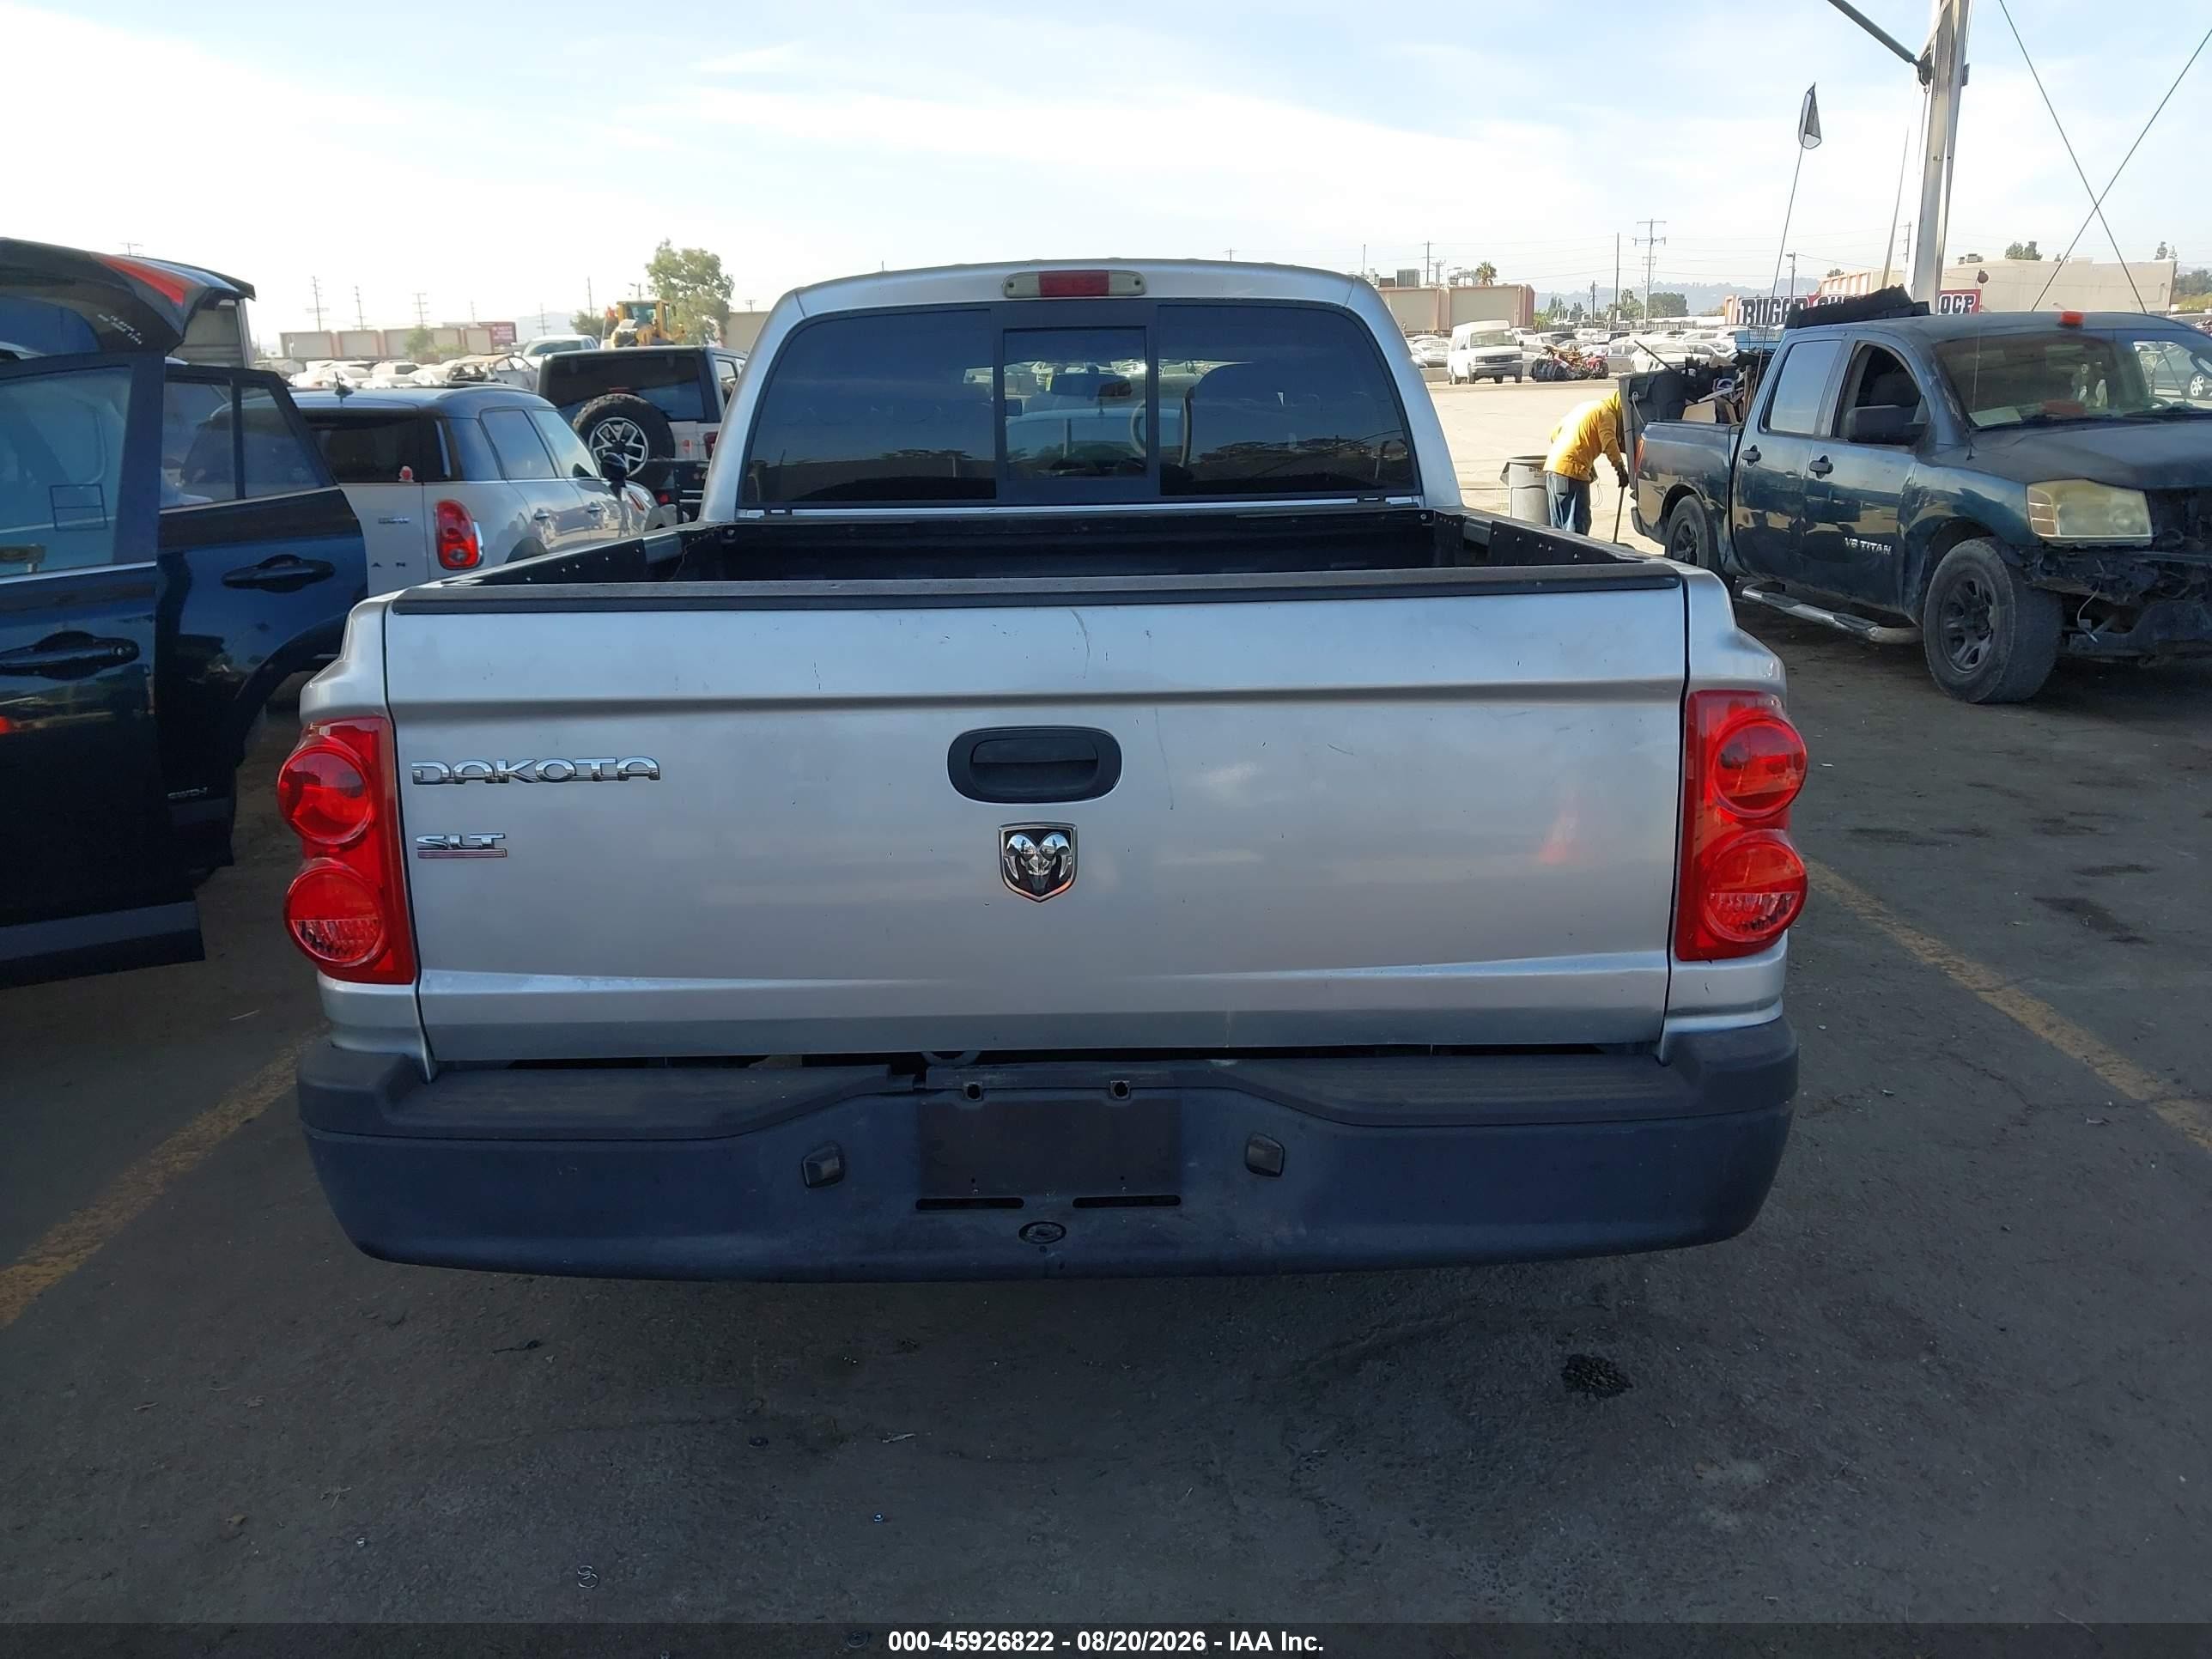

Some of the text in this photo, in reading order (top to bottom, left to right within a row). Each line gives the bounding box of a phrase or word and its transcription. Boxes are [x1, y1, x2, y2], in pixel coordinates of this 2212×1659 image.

[1860, 540, 1893, 556] TITAN
[411, 757, 661, 785] DAKOTA
[416, 833, 506, 850] SLT
